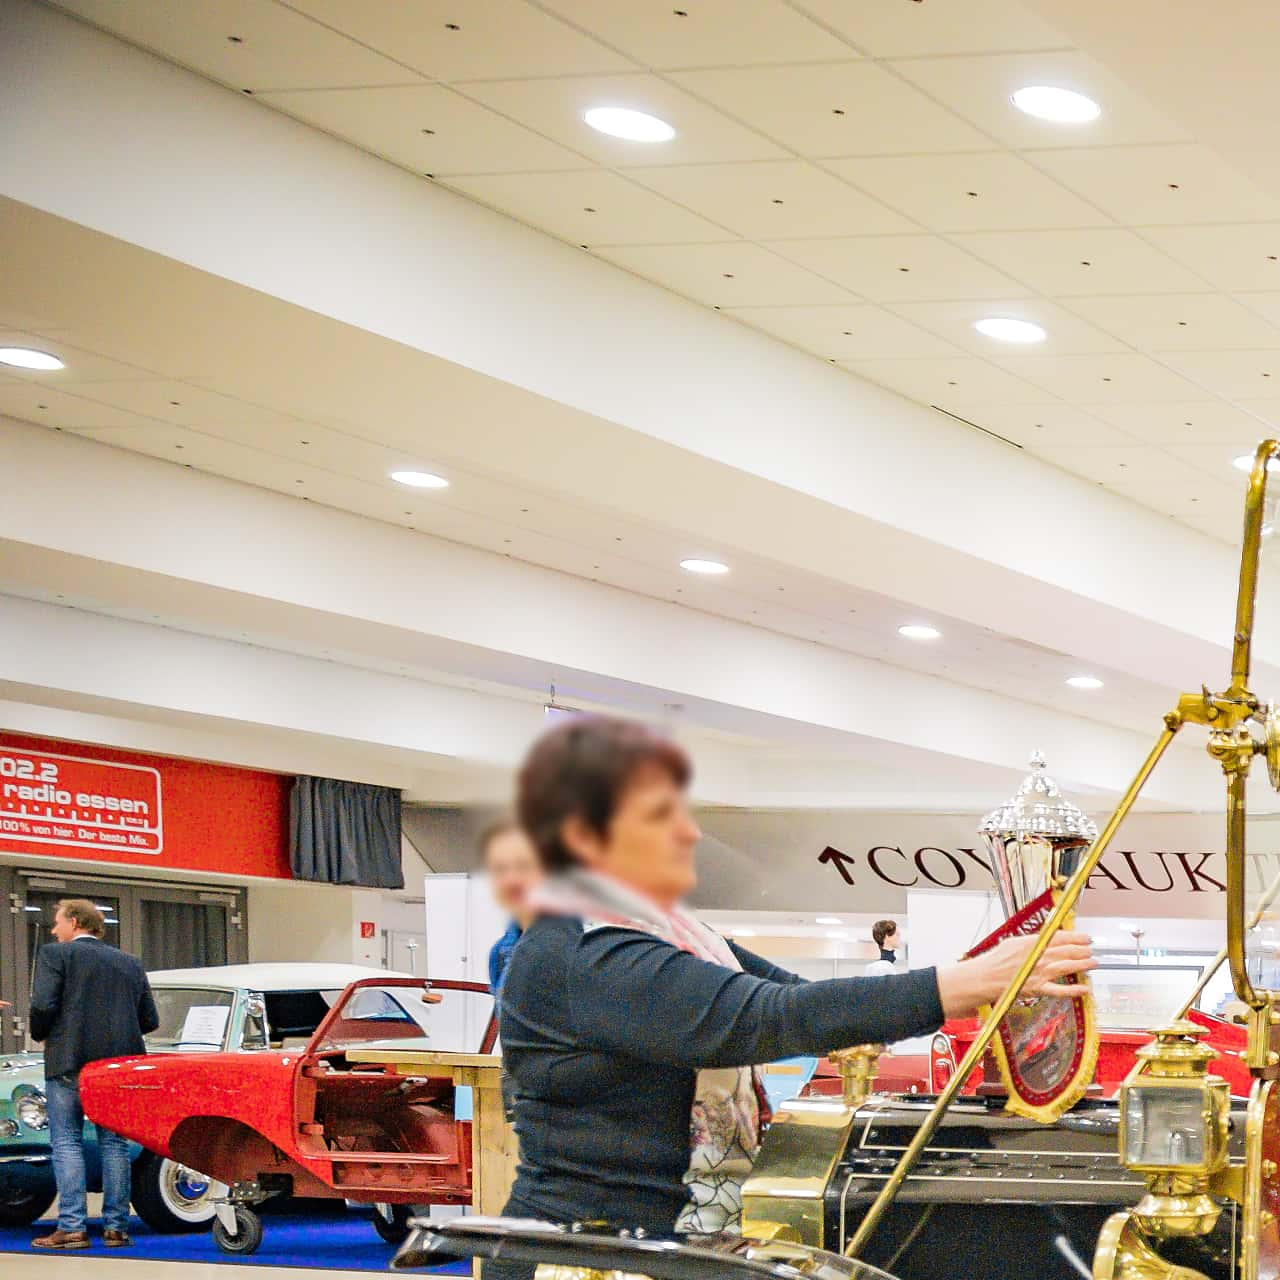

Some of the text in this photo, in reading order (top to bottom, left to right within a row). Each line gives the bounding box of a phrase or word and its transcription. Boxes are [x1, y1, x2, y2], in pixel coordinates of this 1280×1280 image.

[3, 783, 149, 815] radio essen
[32, 825, 51, 835] von
[53, 824, 75, 838] hier.
[78, 828, 97, 840] Der
[99, 831, 127, 844] beste
[129, 833, 150, 846] Mix.
